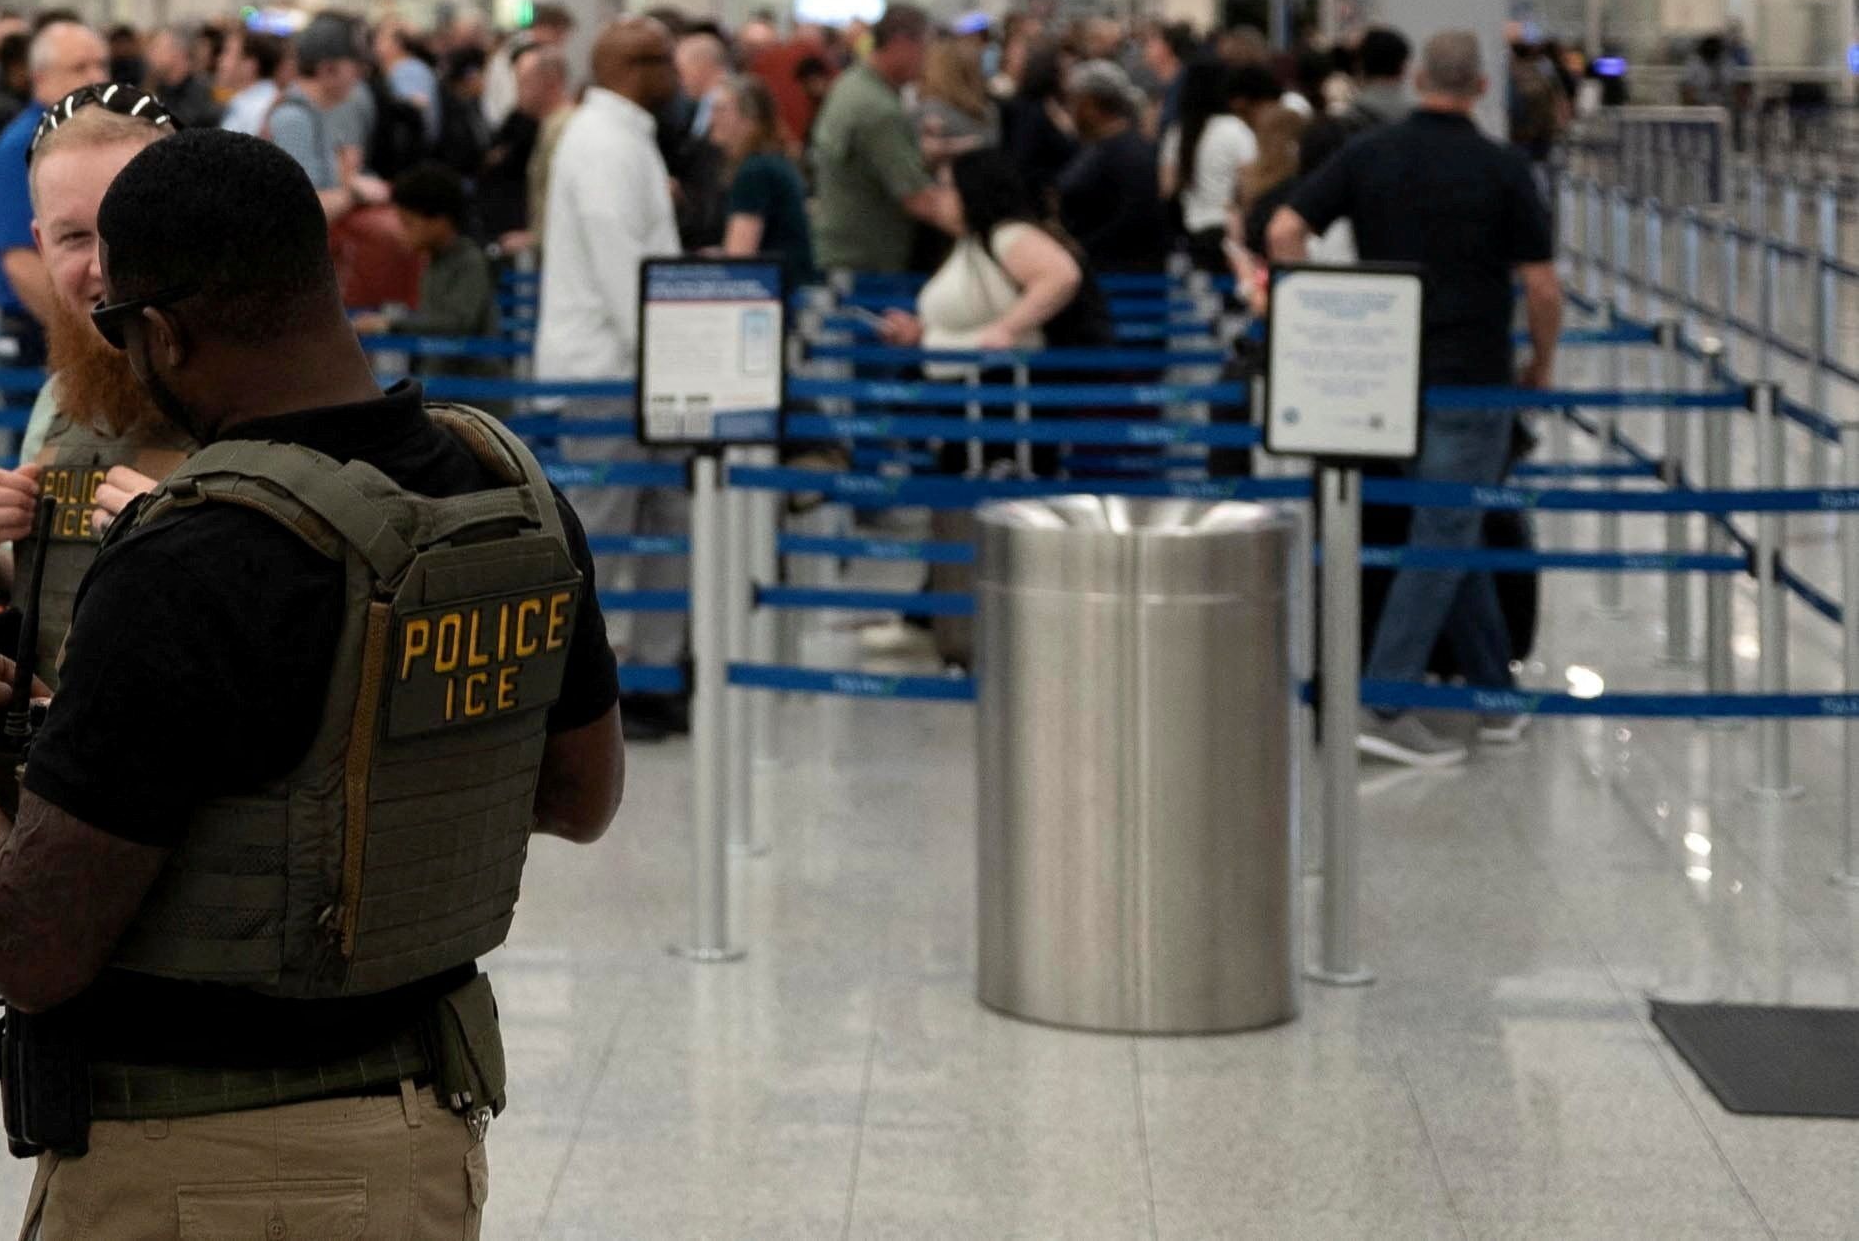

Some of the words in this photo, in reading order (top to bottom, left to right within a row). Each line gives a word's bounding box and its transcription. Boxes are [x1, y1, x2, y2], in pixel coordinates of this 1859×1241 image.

[43, 470, 108, 505] POLIC
[52, 509, 92, 537] ICE
[400, 591, 572, 681] POLICE
[444, 665, 521, 722] ICE
